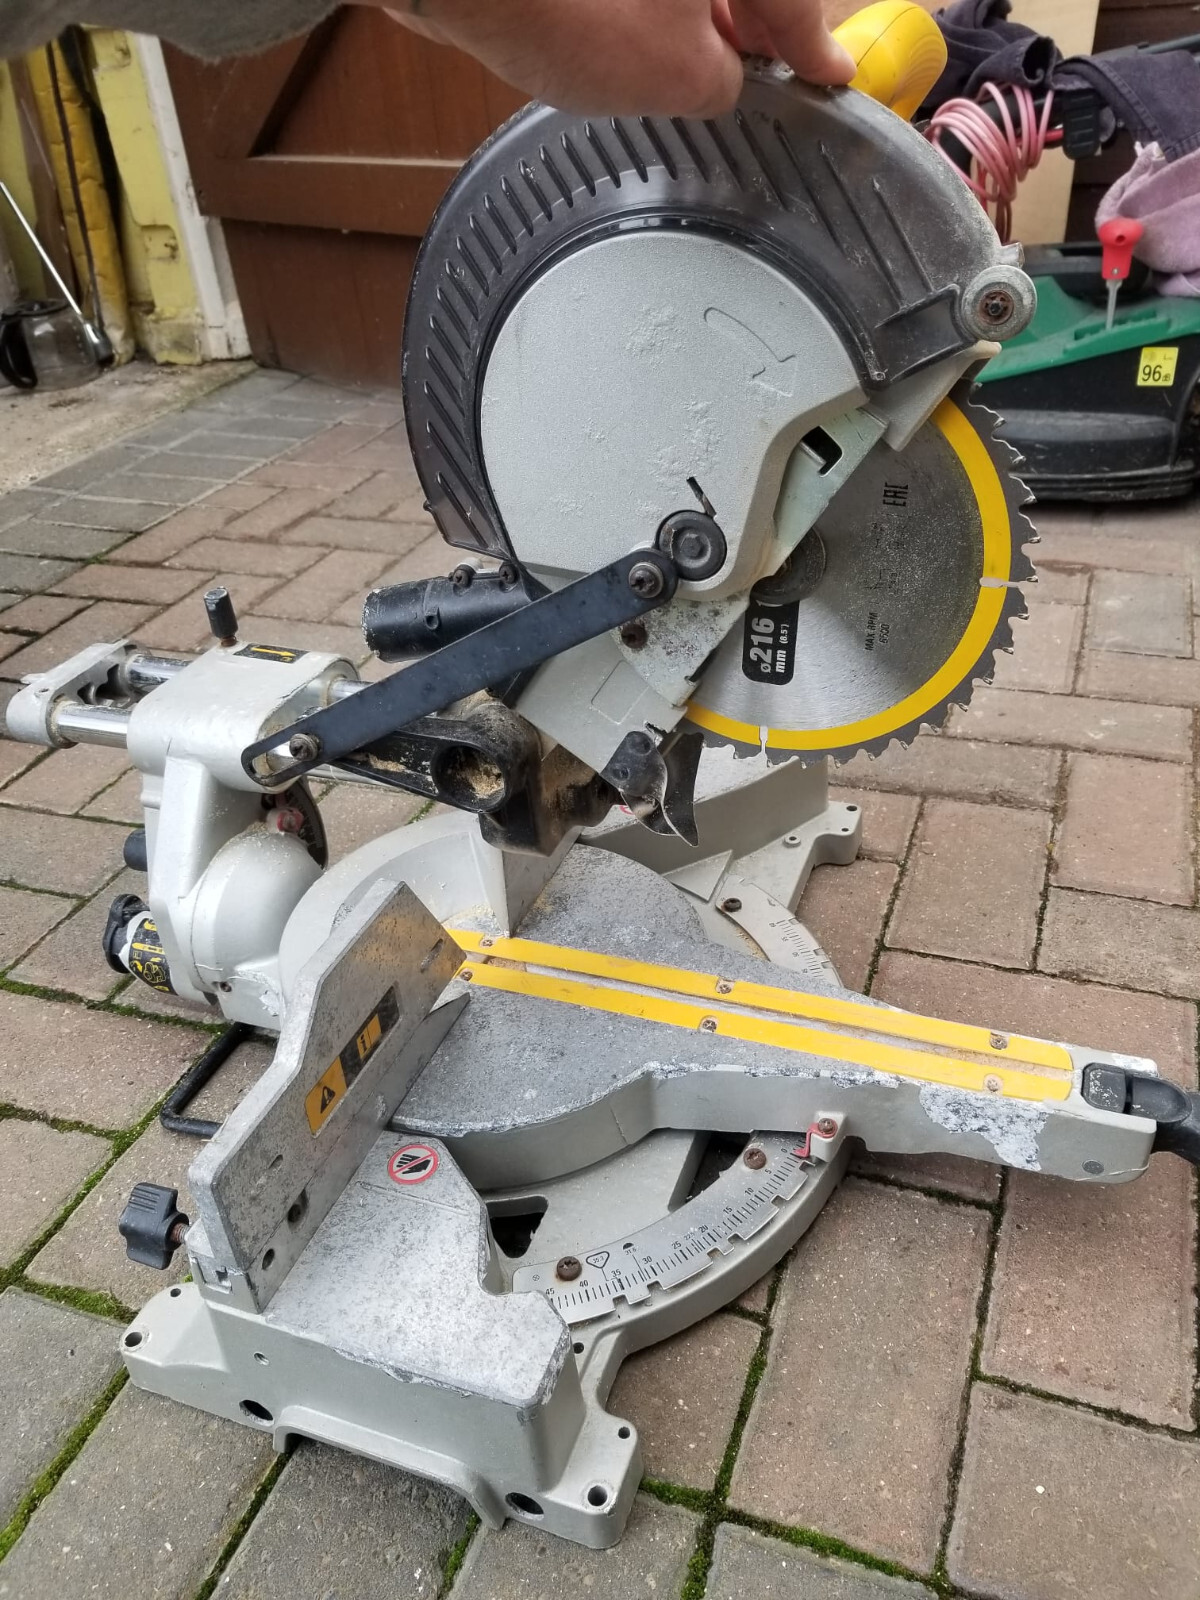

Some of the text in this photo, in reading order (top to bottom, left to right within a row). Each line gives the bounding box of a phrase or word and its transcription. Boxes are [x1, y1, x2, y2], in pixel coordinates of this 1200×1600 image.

[1142, 365, 1162, 381] 96
[865, 611, 878, 651] MAX RPM
[775, 649, 787, 673] mm
[579, 1279, 589, 1288] 40
[611, 1268, 622, 1278] 35
[642, 1255, 653, 1265] 30
[671, 1240, 682, 1250] 25
[698, 1224, 709, 1234] 20
[722, 1206, 733, 1215] 15
[744, 1187, 754, 1196] 10
